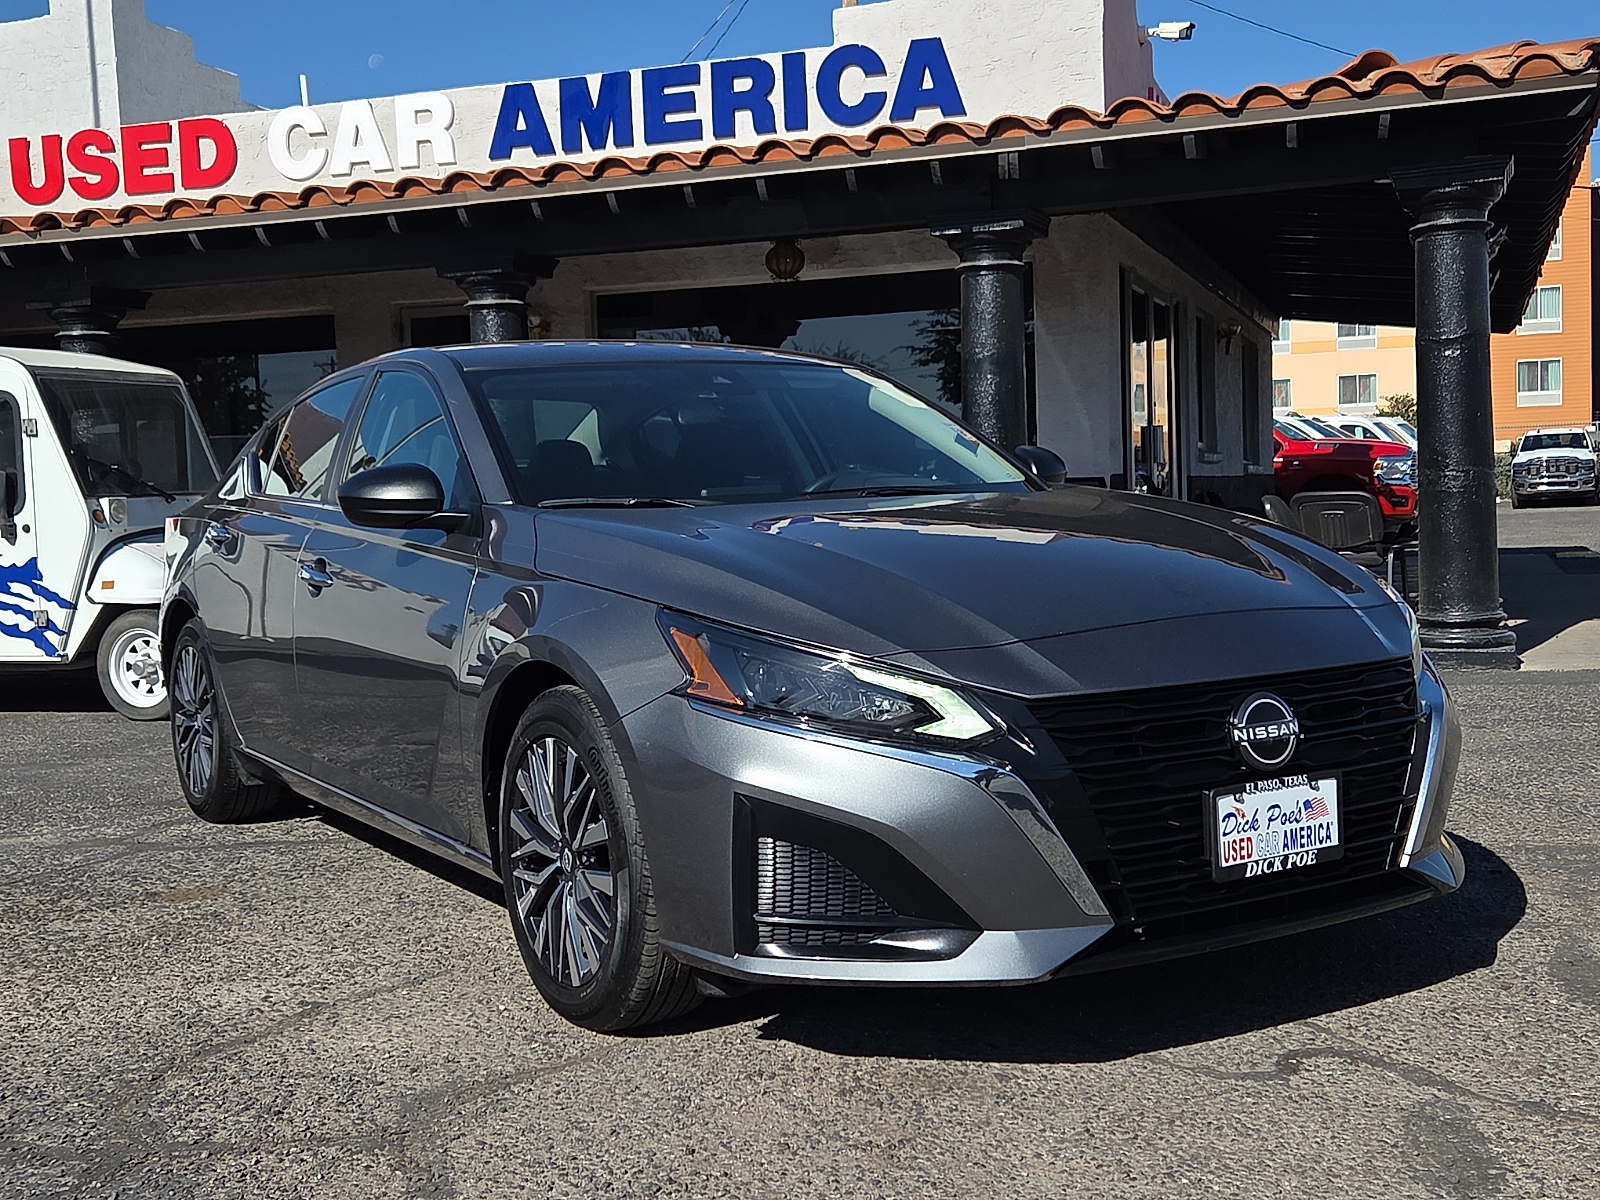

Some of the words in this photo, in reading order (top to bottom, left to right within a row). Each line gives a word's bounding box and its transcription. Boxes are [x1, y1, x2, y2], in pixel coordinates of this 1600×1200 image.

[8, 117, 238, 206] USED
[267, 91, 457, 181] CAR
[488, 37, 966, 161] AMERICA
[1233, 722, 1298, 741] NISSAN
[1245, 783, 1255, 794] EL
[1284, 774, 1308, 787] TEXAS
[1221, 807, 1260, 837] Dick
[1266, 799, 1304, 830] Poe's
[1223, 836, 1253, 864] USED
[1256, 830, 1280, 858] CAR
[1282, 821, 1332, 852] AMERICA
[1245, 856, 1284, 878] DICK
[1286, 850, 1317, 869] POE
